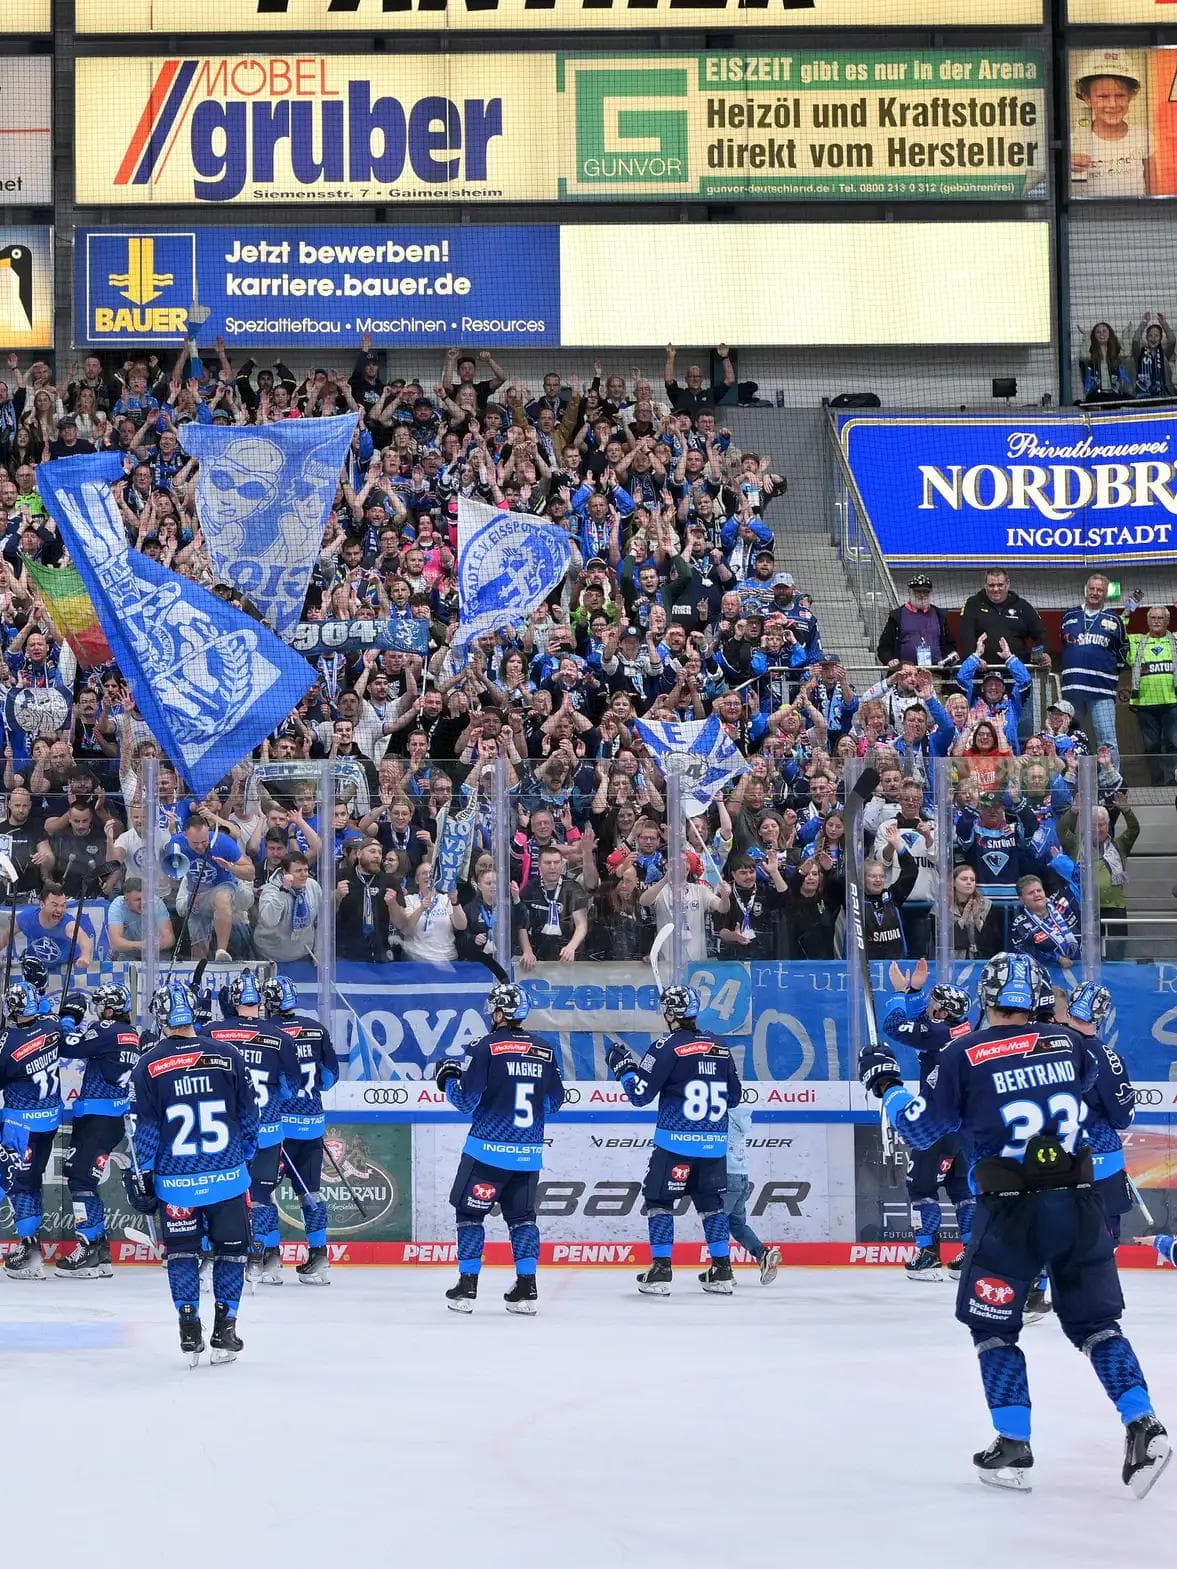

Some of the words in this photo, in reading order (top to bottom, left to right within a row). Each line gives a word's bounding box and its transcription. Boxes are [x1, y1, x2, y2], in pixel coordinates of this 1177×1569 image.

[205, 59, 339, 97] MÖBEL
[706, 57, 793, 81] EISZEIT
[800, 60, 839, 84] gibt
[845, 64, 868, 81] es
[874, 62, 907, 81] nur
[914, 59, 933, 80] in
[939, 59, 972, 80] der
[978, 59, 1037, 80] Arena
[707, 97, 801, 129] Heizöl
[812, 97, 867, 128] und
[878, 95, 1037, 128] Kraftstoffe
[190, 80, 503, 202] gruber
[707, 138, 797, 169] direkt
[809, 142, 873, 168] vom
[887, 136, 1038, 168] Hersteller
[583, 157, 682, 178] GUNVOR
[253, 189, 353, 199] Siemensstr.
[360, 189, 369, 198] 7
[388, 187, 503, 199] Gaimersheim
[707, 183, 830, 196] gunvor-deutschland.de
[839, 183, 857, 193] Tel.
[860, 184, 884, 193] 0800
[940, 183, 1015, 195] (gebührenfrei)
[225, 241, 290, 264] Jetzt
[299, 240, 449, 264] bewerben!
[226, 272, 472, 297] karriere.bauer.de
[95, 307, 188, 333] BAUER
[225, 316, 342, 335] Spezialtiefbau
[356, 316, 446, 333] Maschinen
[461, 316, 545, 333] Resources
[1006, 431, 1171, 459] Privatbrauerei
[1006, 523, 1172, 548] INGOLSTADT
[518, 978, 658, 1011] Szene
[506, 1061, 543, 1079] WAGNER
[992, 1060, 1076, 1095] BERTRAND
[174, 1075, 213, 1096] HÜTTL
[589, 1089, 631, 1103] Aud
[767, 1089, 816, 1104] Audi
[513, 1081, 535, 1128] 5
[682, 1080, 728, 1123] 85
[166, 1100, 229, 1157] 25
[1001, 1092, 1082, 1158] 33
[162, 1169, 242, 1189] INGOLSTADT
[968, 1298, 1013, 1316] Backhaus
[968, 1306, 1009, 1321] Hackner
